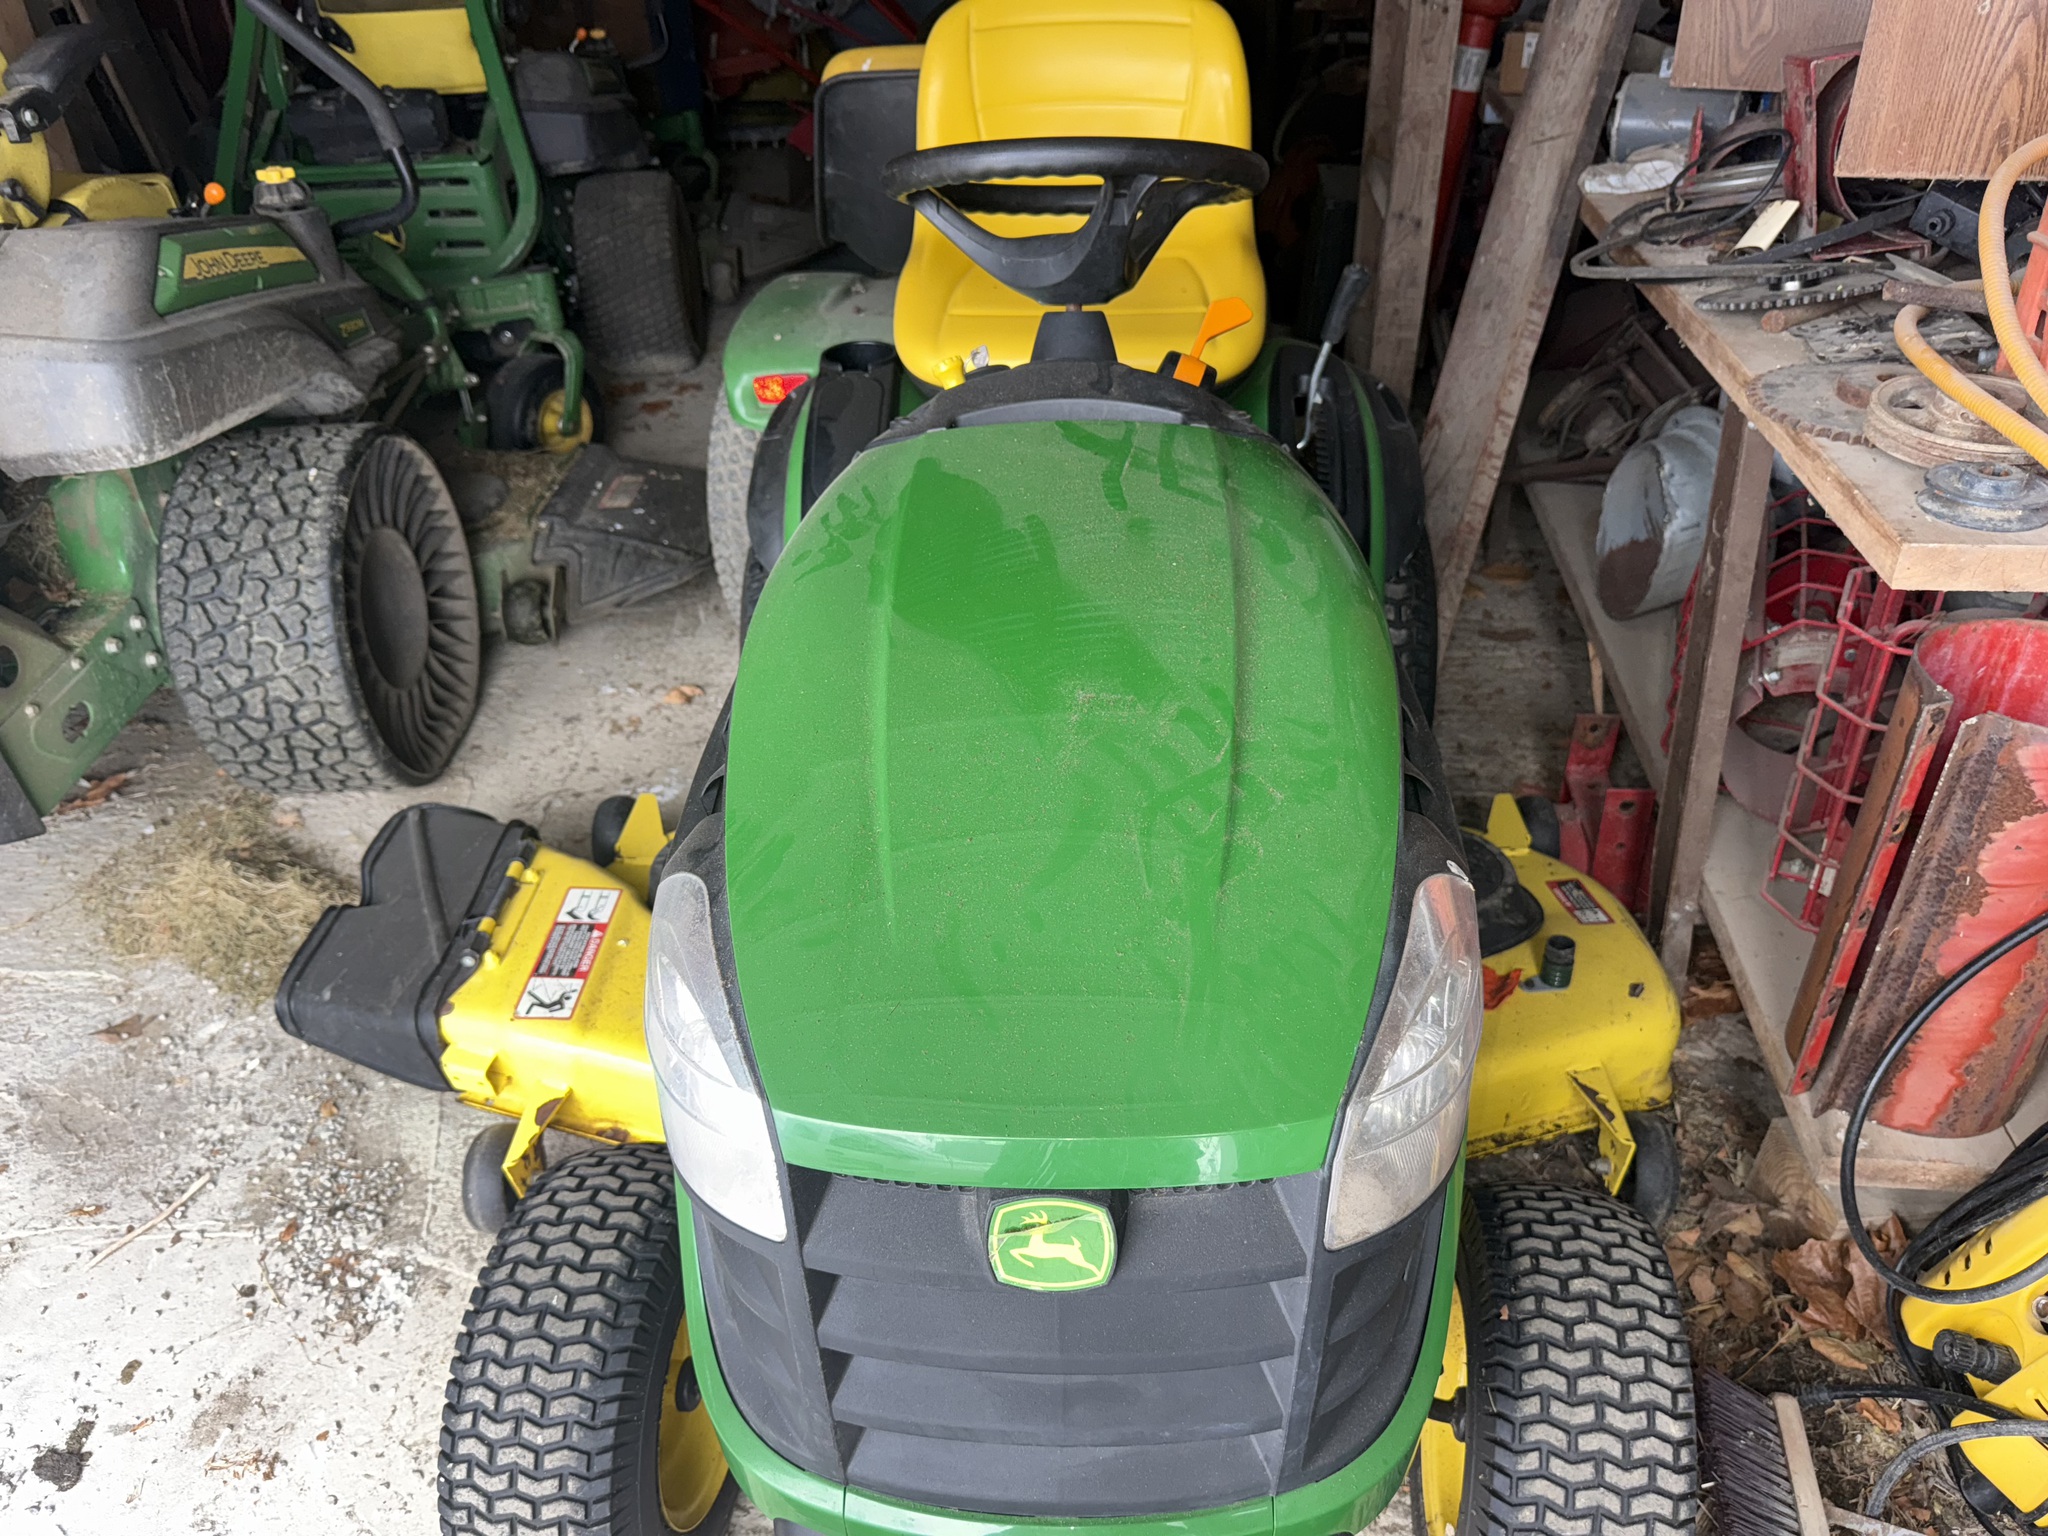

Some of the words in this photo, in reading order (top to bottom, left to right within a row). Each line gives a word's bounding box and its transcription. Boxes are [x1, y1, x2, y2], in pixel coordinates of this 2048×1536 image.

[190, 256, 229, 277] JOHN
[221, 250, 268, 269] DEERE
[579, 937, 601, 972] DANGER
